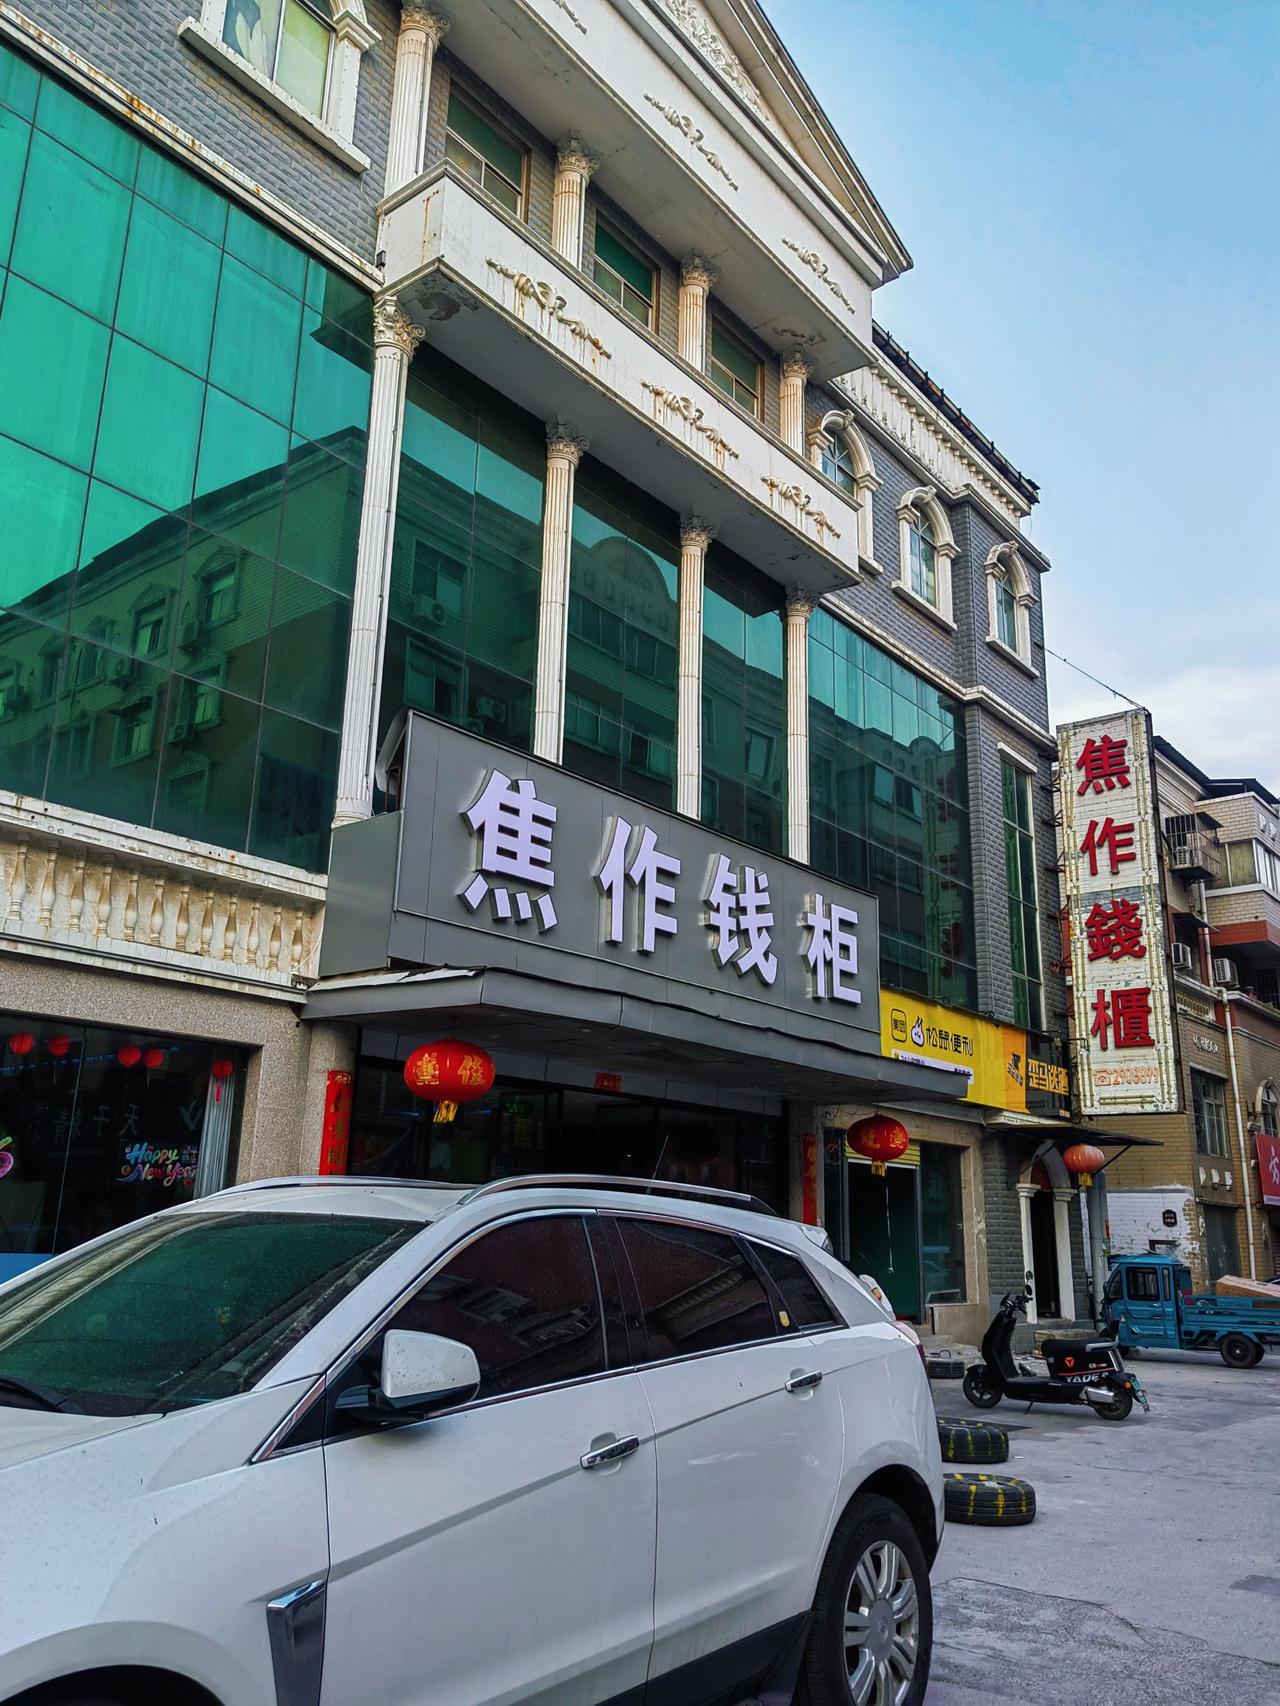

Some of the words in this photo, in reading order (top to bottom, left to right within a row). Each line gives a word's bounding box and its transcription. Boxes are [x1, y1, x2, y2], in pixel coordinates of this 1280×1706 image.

[457, 768, 862, 1006] 焦作钱柜
[1076, 735, 1156, 1051] 焦作錢櫃
[925, 1025, 974, 1057] 松鼠便利
[1027, 1057, 1069, 1096] 歪马送酒
[126, 1141, 180, 1166] Happy
[115, 1163, 165, 1184] New
[163, 1161, 198, 1188] Year
